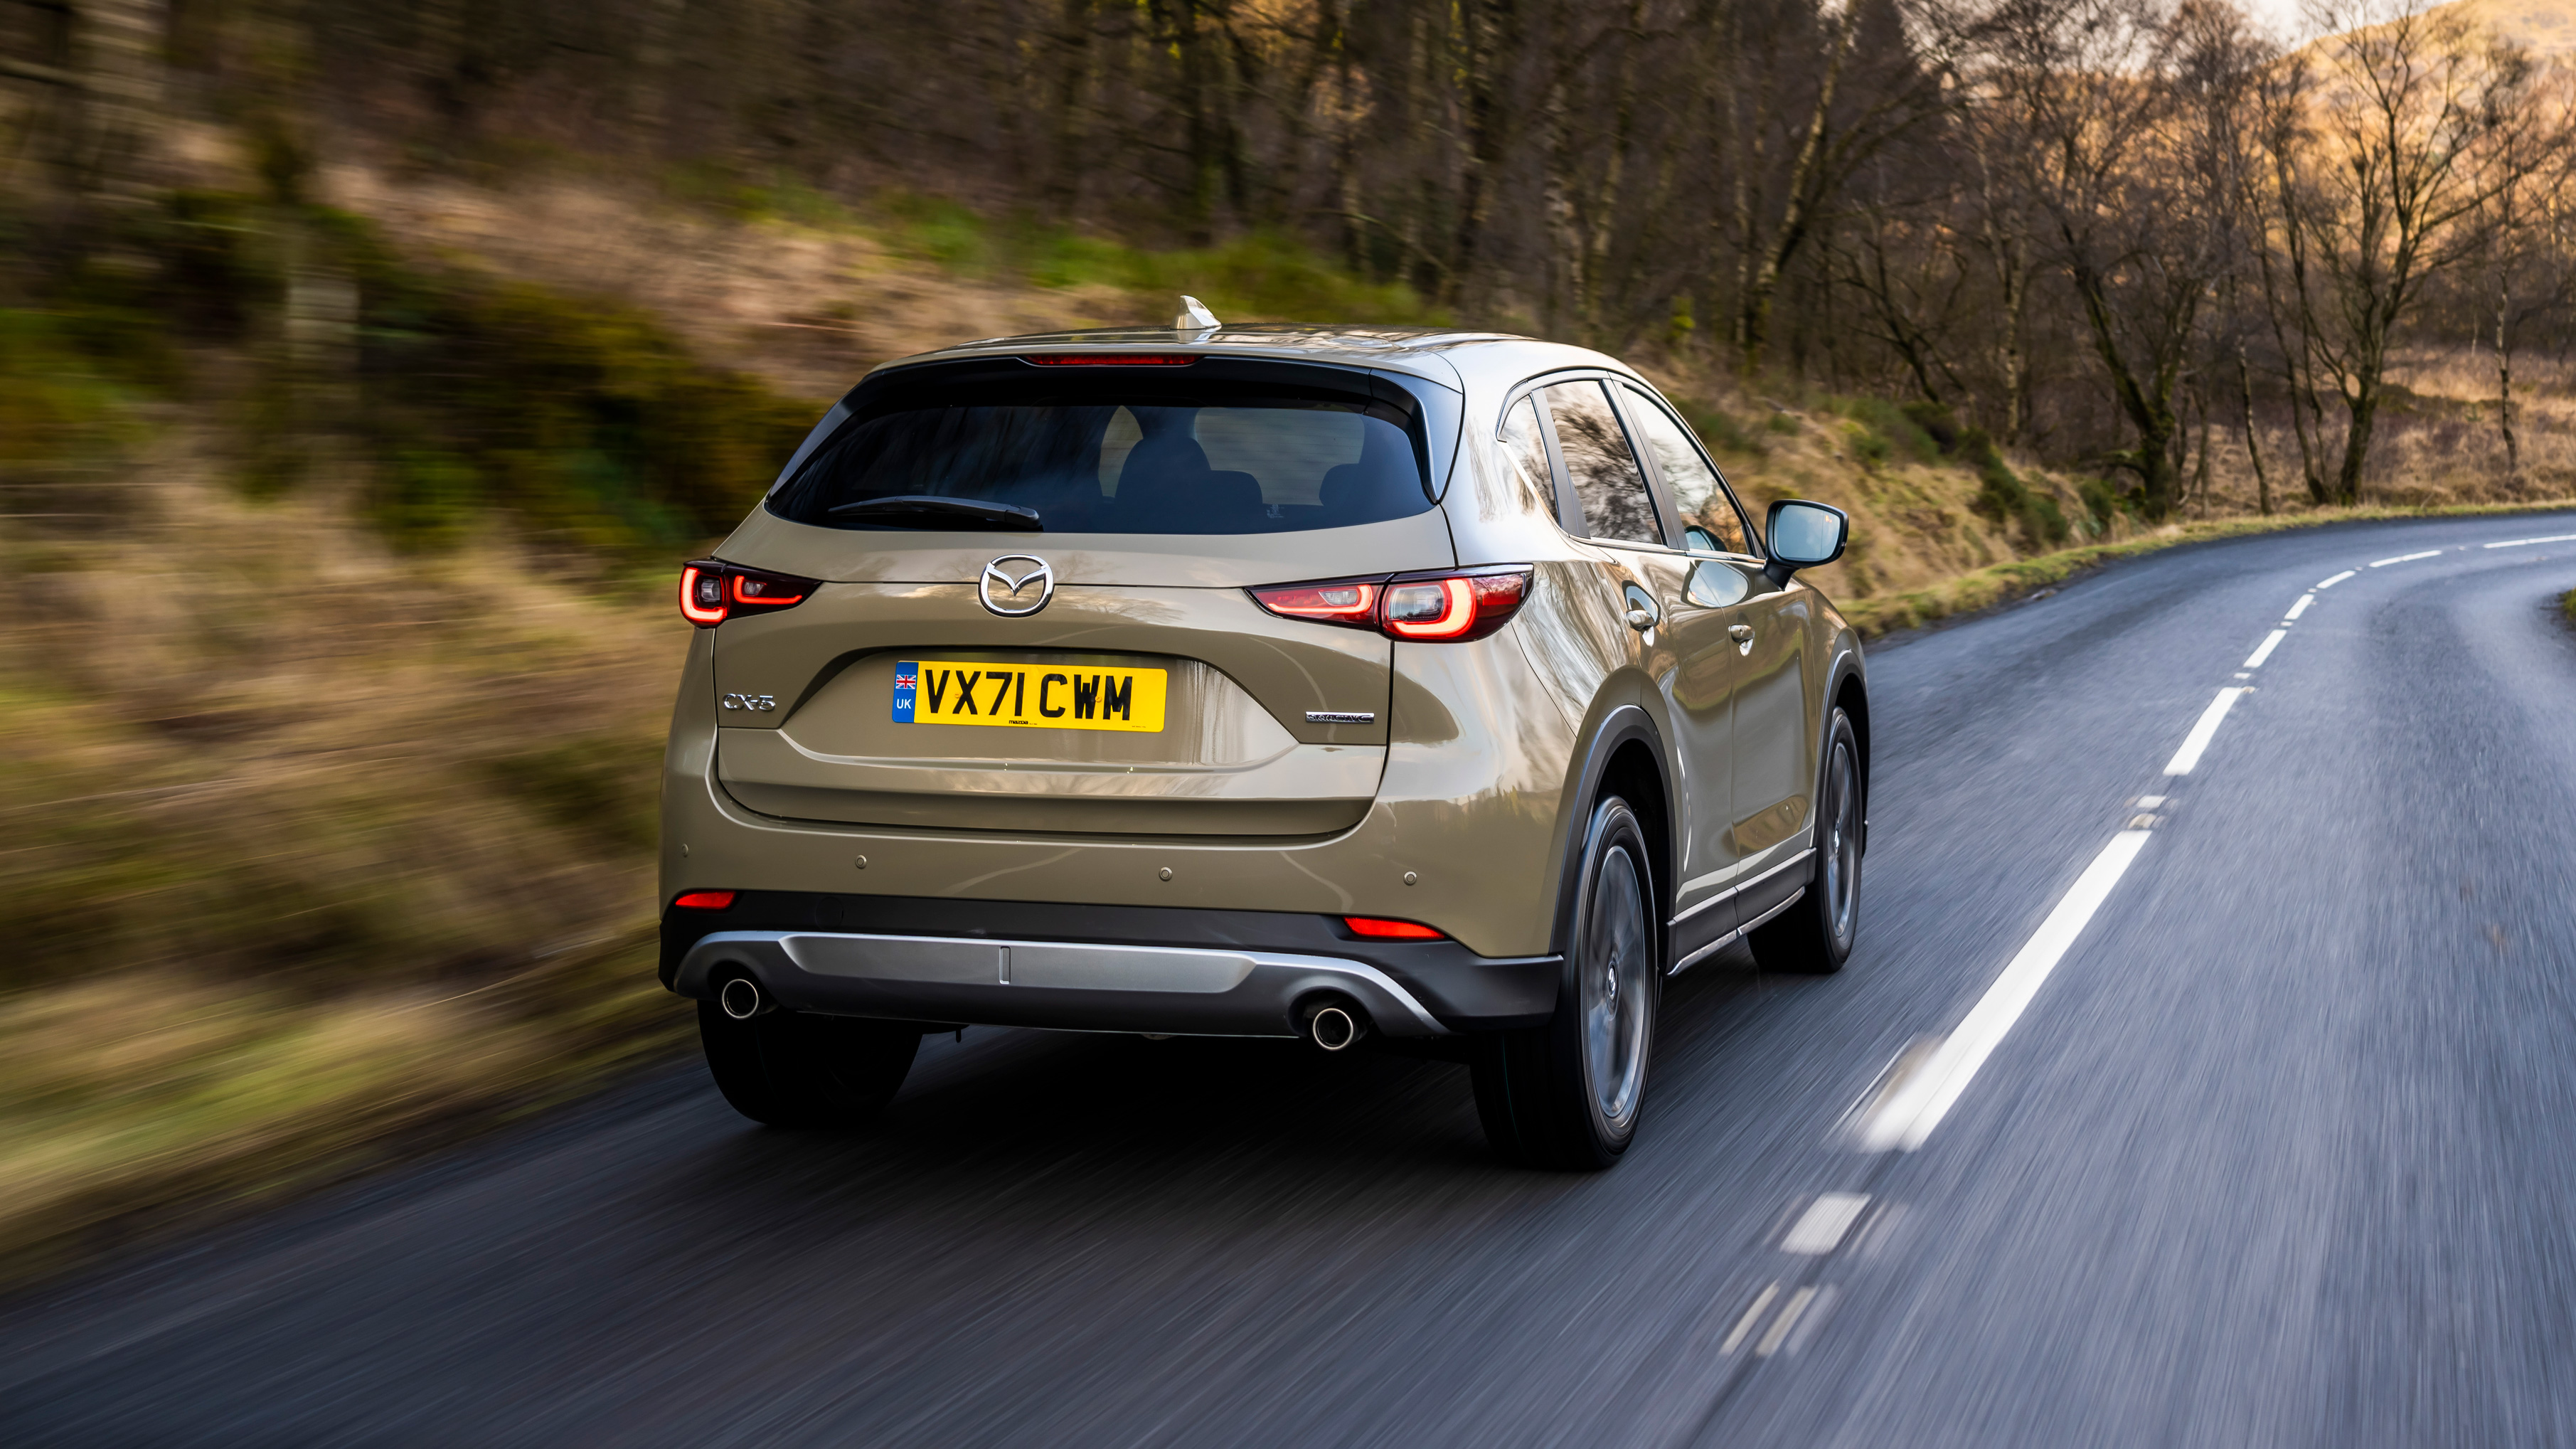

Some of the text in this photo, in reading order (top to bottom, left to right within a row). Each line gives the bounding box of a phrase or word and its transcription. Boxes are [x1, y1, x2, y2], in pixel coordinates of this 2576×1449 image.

[723, 693, 776, 711] CX-5
[896, 699, 911, 709] UK
[925, 669, 1132, 721] VX71 CWM
